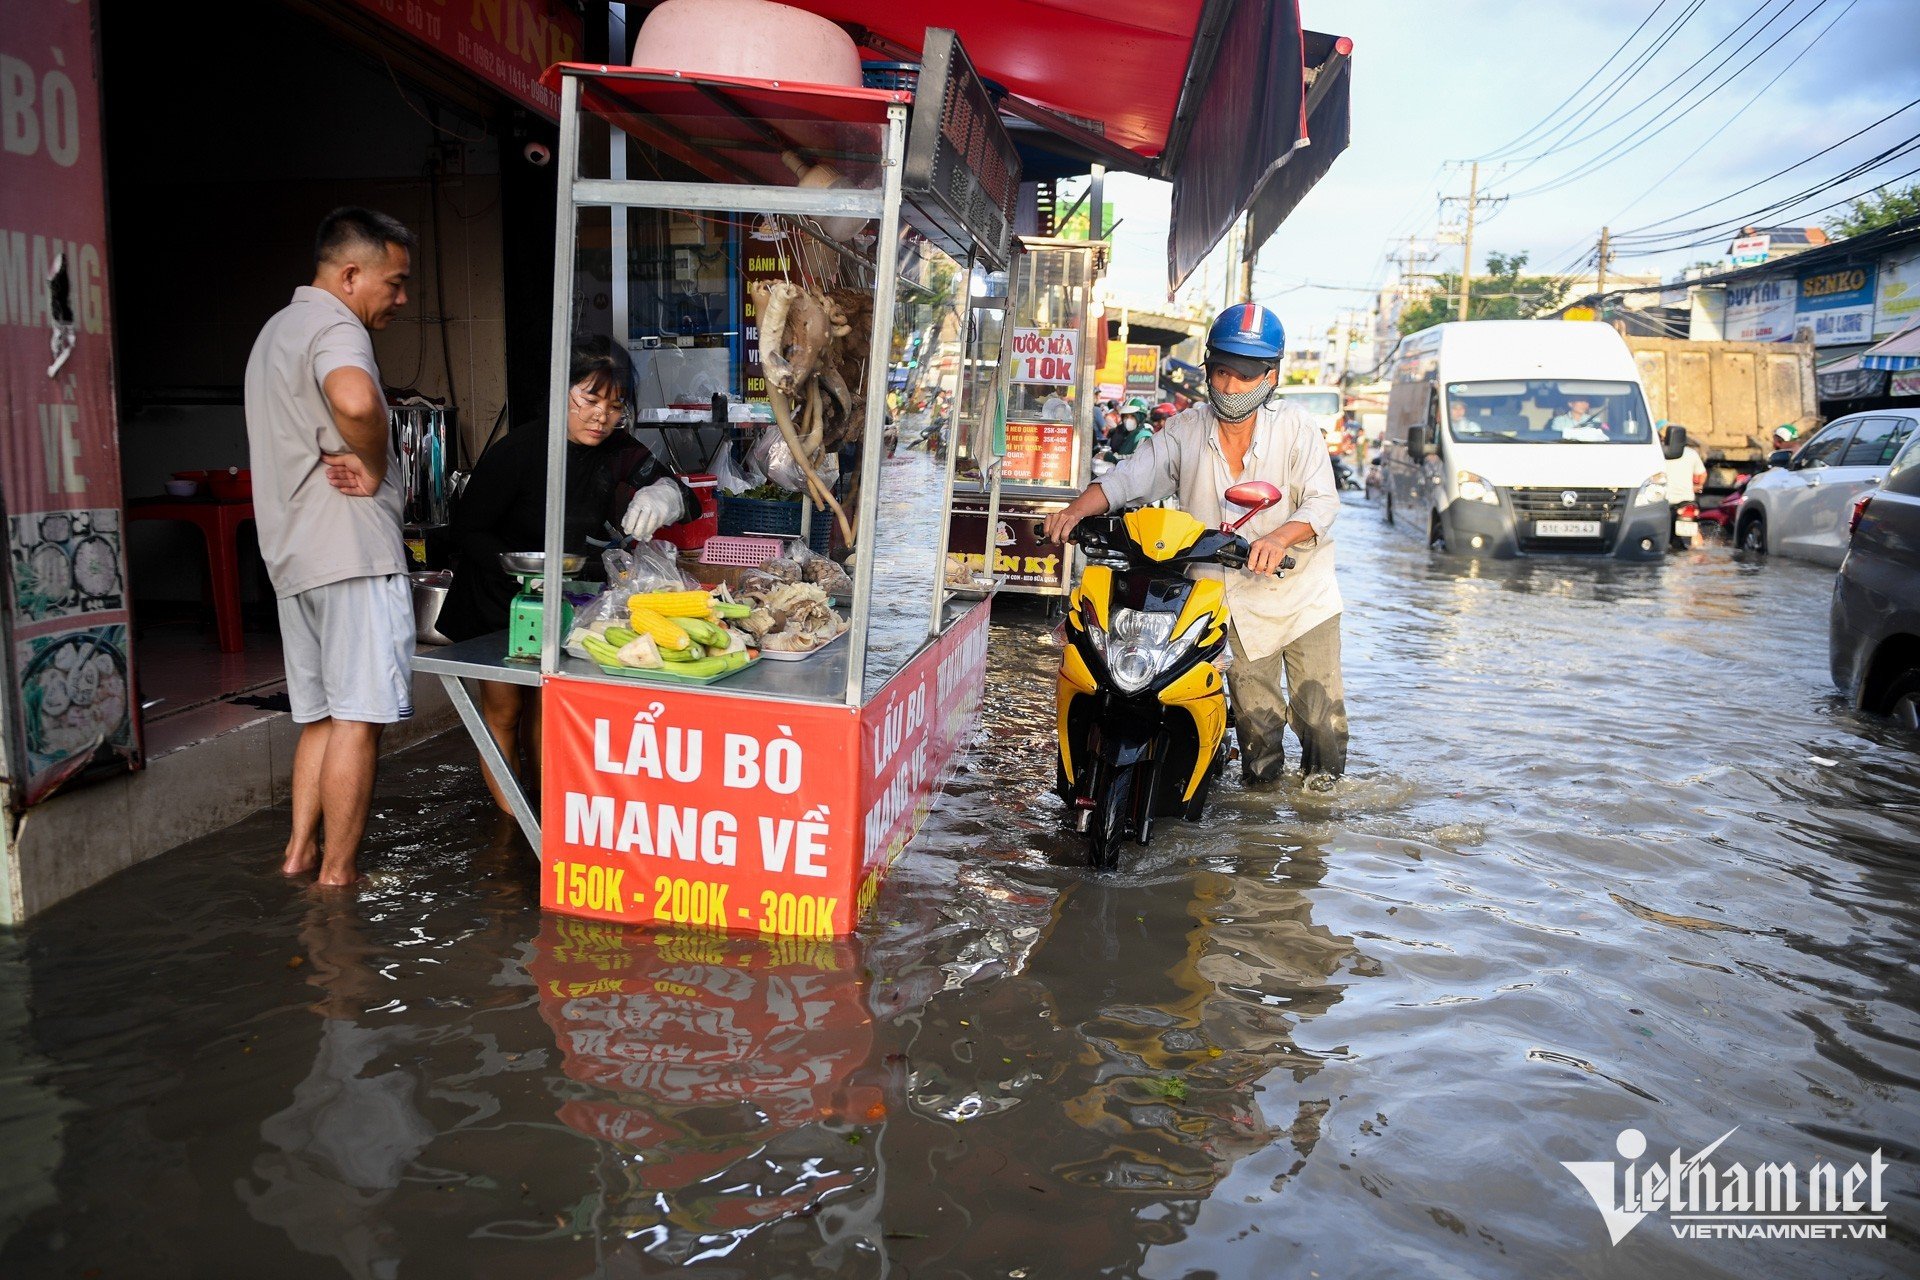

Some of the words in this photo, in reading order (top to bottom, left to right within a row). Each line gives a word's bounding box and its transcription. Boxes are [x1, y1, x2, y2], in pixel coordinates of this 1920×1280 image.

[0, 46, 80, 167] BÒ
[748, 255, 775, 272] BÁNH
[1804, 269, 1867, 298] SENKO
[745, 326, 759, 340] HE
[748, 377, 765, 391] HEO
[1023, 553, 1060, 575] KÝ
[593, 701, 703, 783] LẨU
[723, 724, 804, 795] BÒ
[874, 689, 905, 779] LẨU
[905, 671, 926, 743] BÒ
[863, 761, 909, 867] MANG
[911, 722, 930, 792] VỀ
[564, 791, 738, 867] MANG
[758, 804, 831, 878] VỀ
[552, 861, 625, 913] 150K
[654, 875, 729, 928] 200K
[758, 889, 838, 937] 300K
